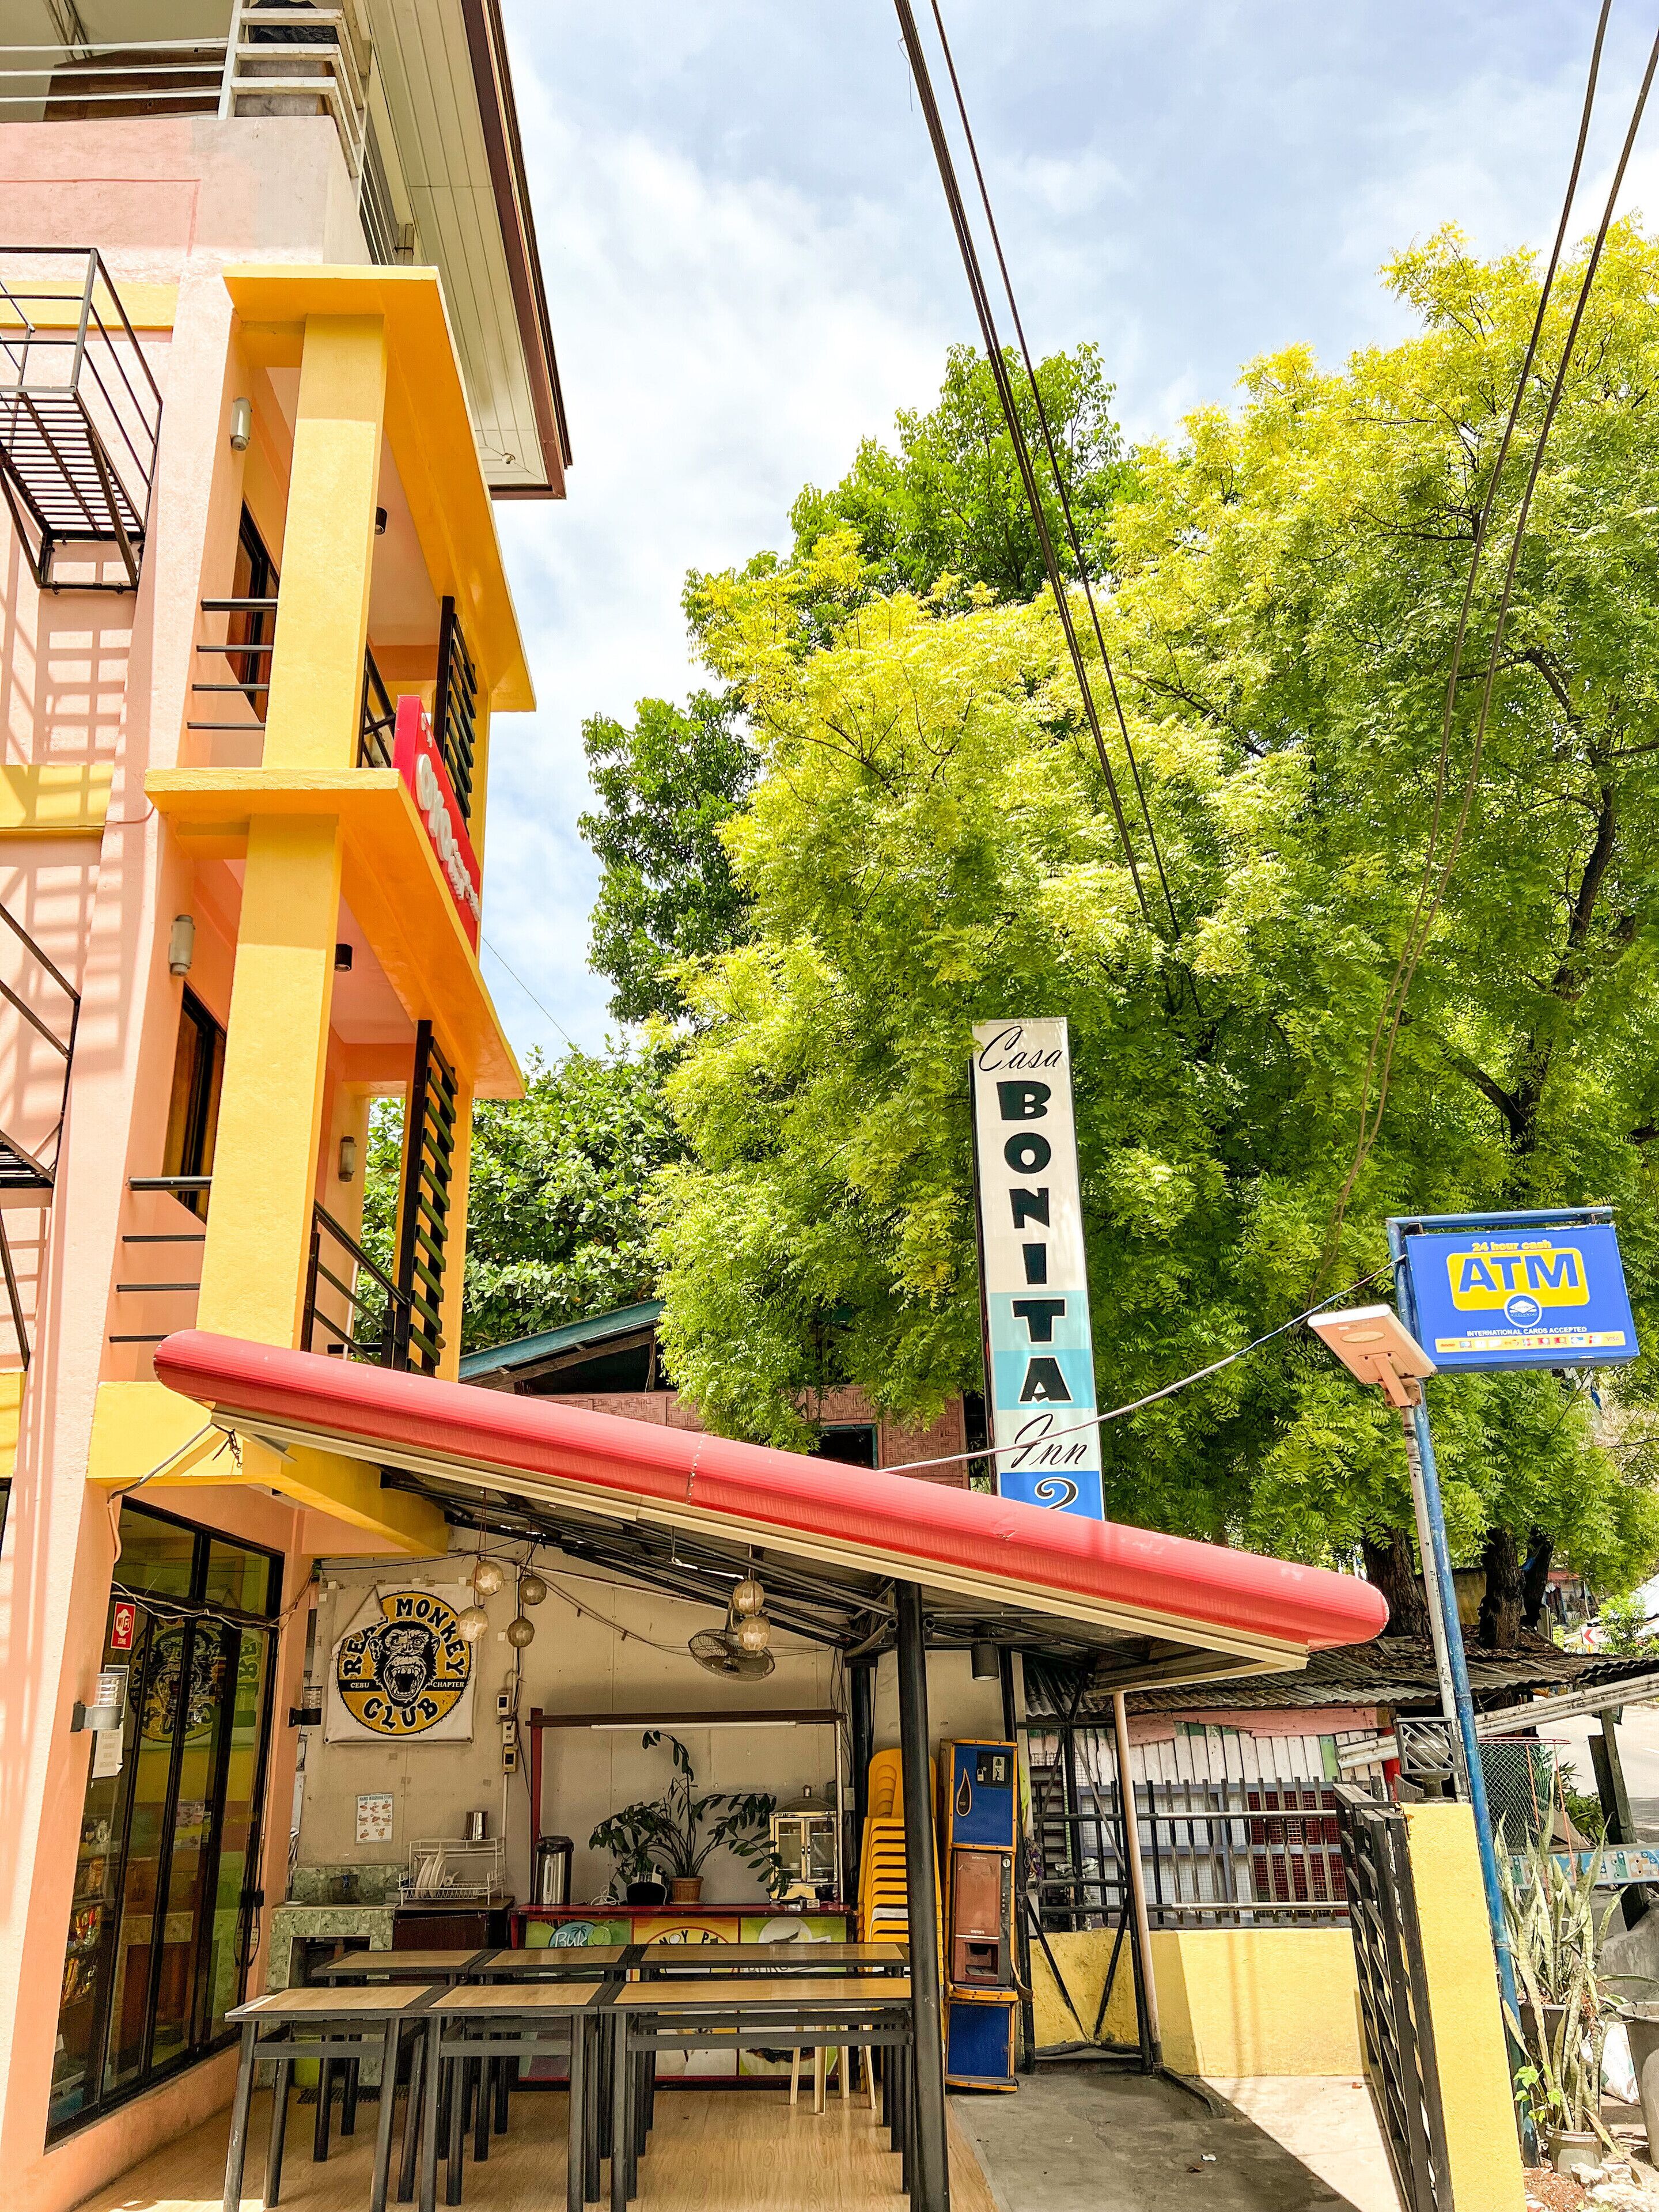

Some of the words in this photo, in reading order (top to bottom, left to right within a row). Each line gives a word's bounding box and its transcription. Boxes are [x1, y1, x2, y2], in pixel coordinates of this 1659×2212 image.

[979, 1025, 1063, 1071] Casa
[996, 1080, 1073, 1402] BONITA
[1472, 1241, 1489, 1252] 24
[1490, 1241, 1519, 1251] hour
[1521, 1239, 1552, 1249] cash
[1459, 1253, 1579, 1293] ATM
[1466, 1329, 1522, 1337] INTERNATIONAL
[1549, 1325, 1588, 1334] ACCEPTED
[1010, 1413, 1088, 1469] Inn
[396, 1597, 466, 1676] MONKEY
[364, 1698, 438, 1729] CLUB
